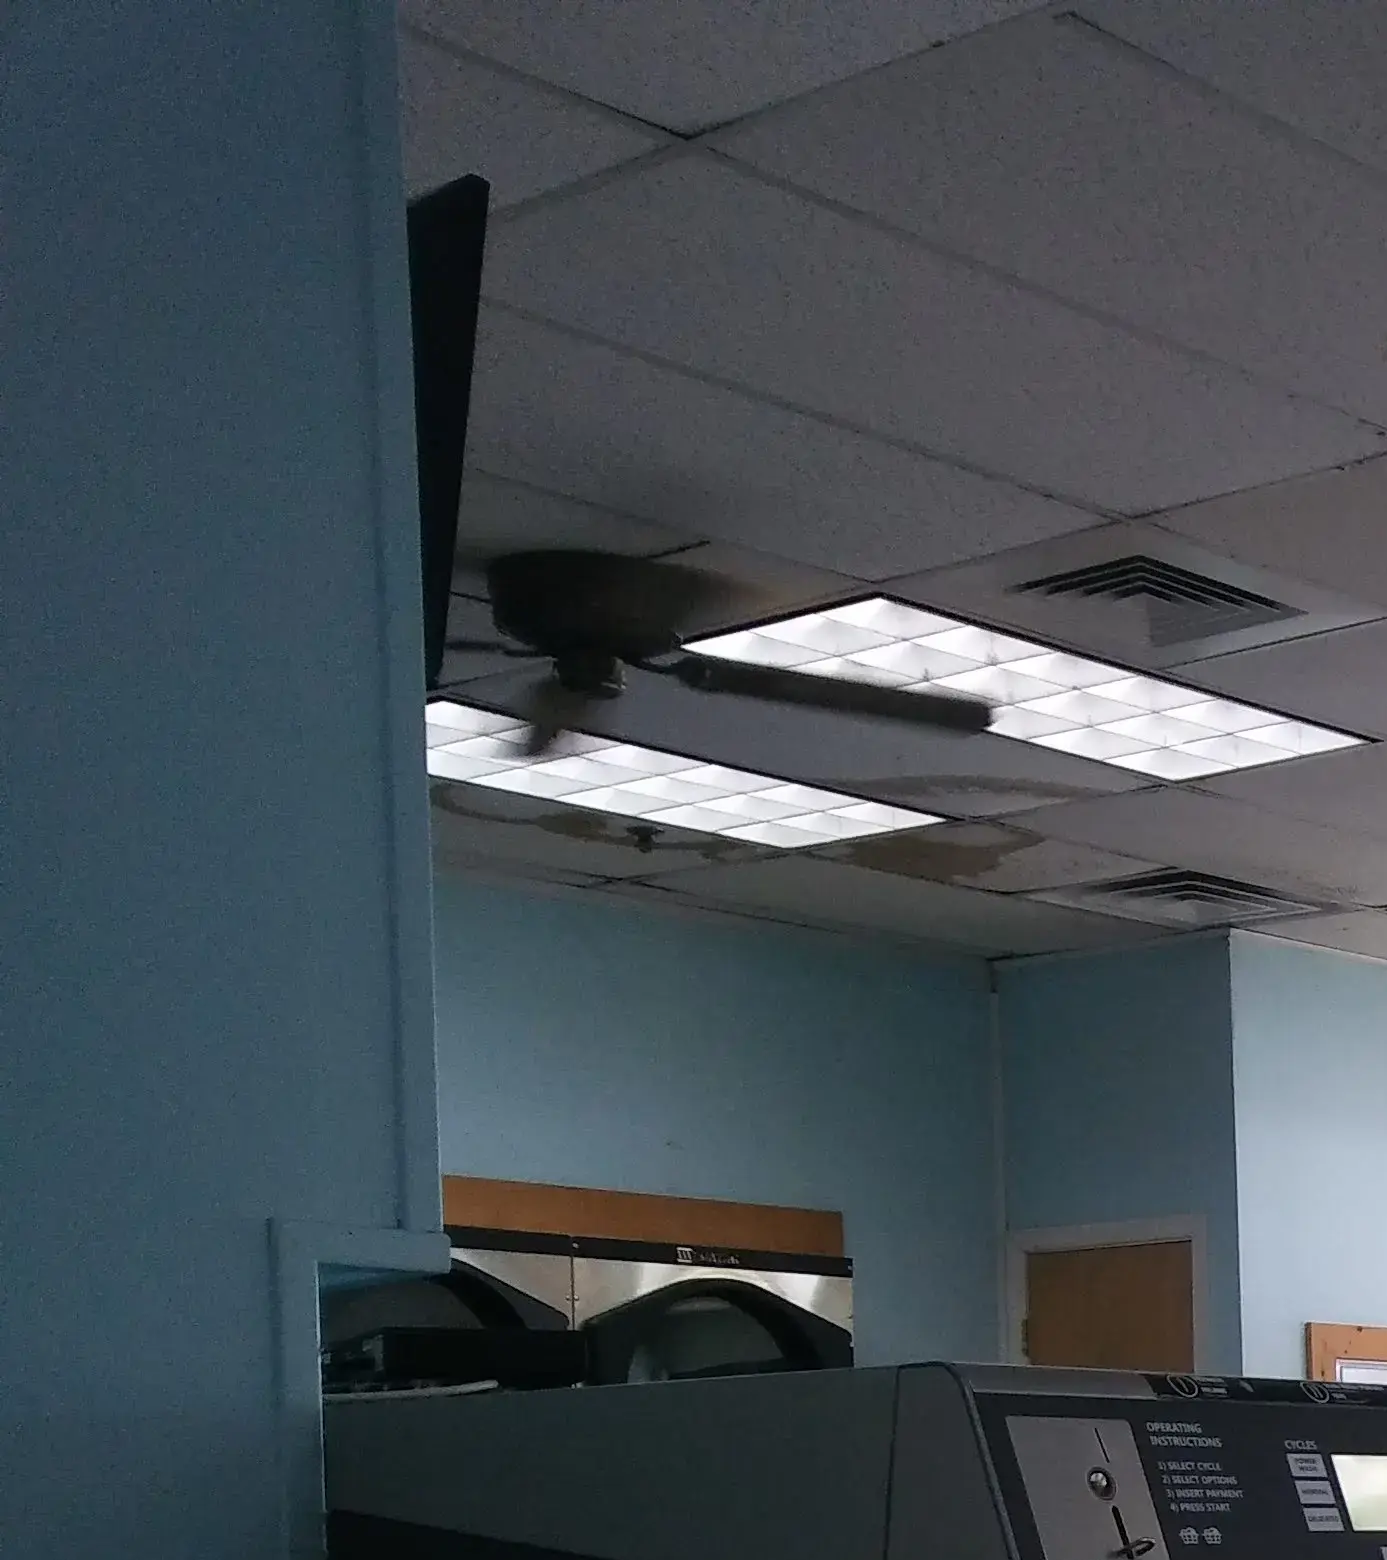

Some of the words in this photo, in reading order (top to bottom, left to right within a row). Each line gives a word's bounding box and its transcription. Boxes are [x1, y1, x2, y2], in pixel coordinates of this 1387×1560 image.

[1146, 1421, 1203, 1434] OPERATING
[1149, 1435, 1223, 1448] INSTRUCTIONS
[1284, 1439, 1318, 1451] CYCLES
[1168, 1461, 1196, 1471] SELECT
[1197, 1462, 1222, 1471] CYCLE
[1172, 1475, 1200, 1485] SELECT
[1201, 1475, 1238, 1485] OPTIONS
[1176, 1488, 1205, 1499] INSERT
[1205, 1489, 1244, 1499] PAYMENT
[1180, 1502, 1205, 1512] PRESS
[1205, 1502, 1231, 1512] START
